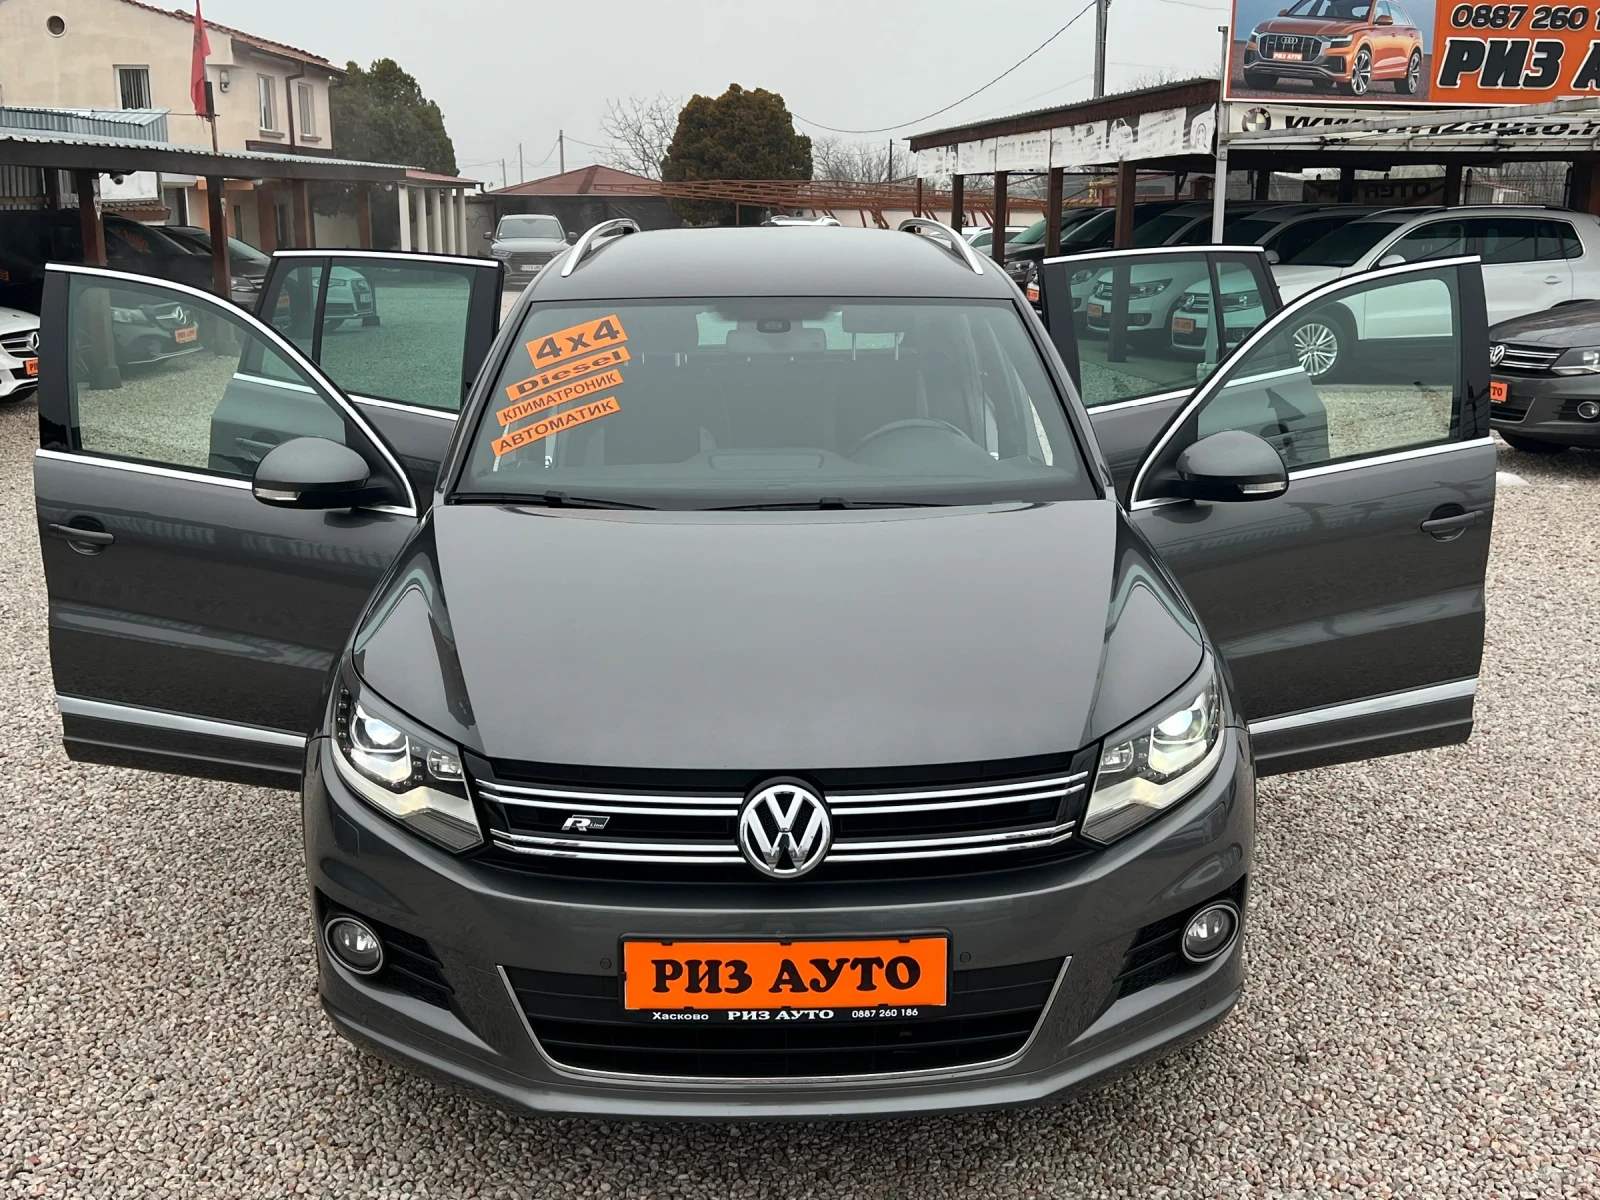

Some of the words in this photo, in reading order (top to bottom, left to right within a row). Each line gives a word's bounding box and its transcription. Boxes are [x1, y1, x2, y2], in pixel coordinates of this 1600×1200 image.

[1451, 4, 1529, 30] 0887
[1530, 5, 1590, 31] 260
[1437, 37, 1566, 90] РИЗ
[535, 319, 620, 360] 4x4
[516, 351, 622, 395] Diesel
[503, 373, 617, 422] КЛИМАТРОНИК
[499, 400, 614, 452] АВТОМАТИК
[651, 959, 753, 994] РИЗ
[768, 955, 921, 994] АУТО
[652, 1011, 710, 1020] Хасково
[727, 1010, 771, 1021] РИЗ
[774, 1009, 835, 1020] АУТО
[851, 1009, 877, 1018] 0887
[879, 1008, 898, 1017] 260
[901, 1008, 919, 1016] 186
